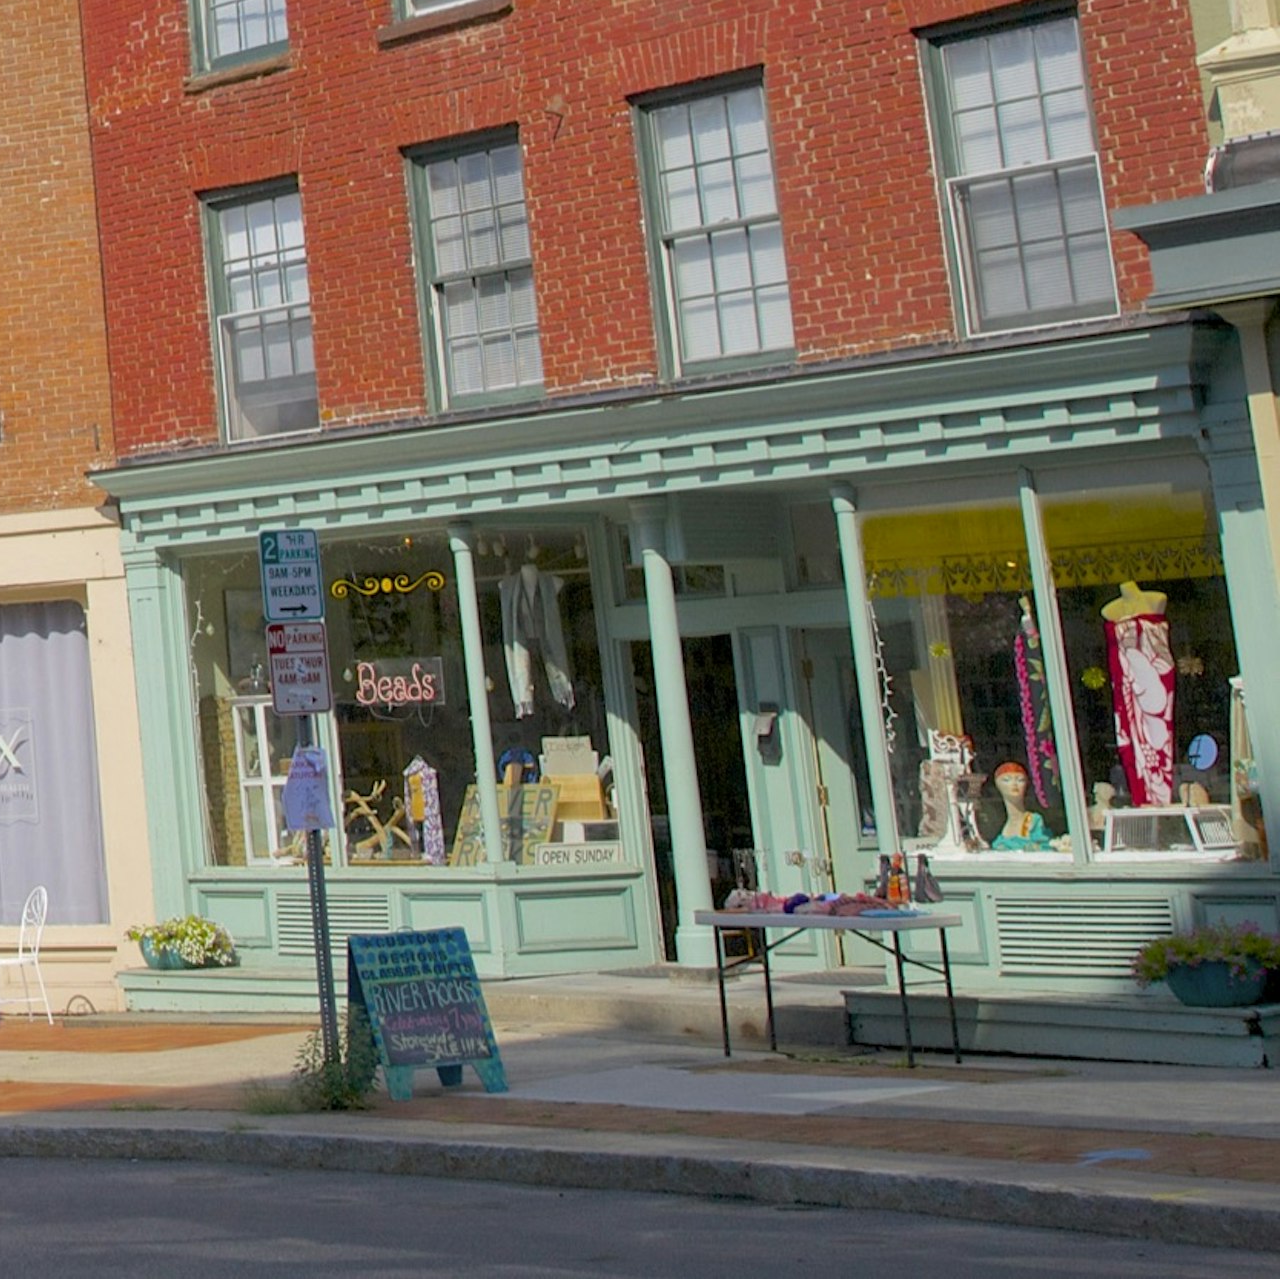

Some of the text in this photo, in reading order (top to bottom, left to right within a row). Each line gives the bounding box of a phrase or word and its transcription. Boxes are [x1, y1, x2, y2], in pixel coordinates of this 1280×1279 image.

[263, 535, 305, 560] 2 HR
[280, 547, 317, 560] PARKING
[269, 567, 311, 580] 9AM-5PM
[270, 584, 317, 598] WEEKDAYS
[269, 630, 323, 649] NO PARKING
[356, 662, 435, 706] Beads
[542, 849, 614, 865] OPEN SUNDAY
[377, 932, 439, 948] CUSTOM
[378, 948, 448, 965] DESIGNS
[372, 979, 477, 1014] RIVER ROCKS
